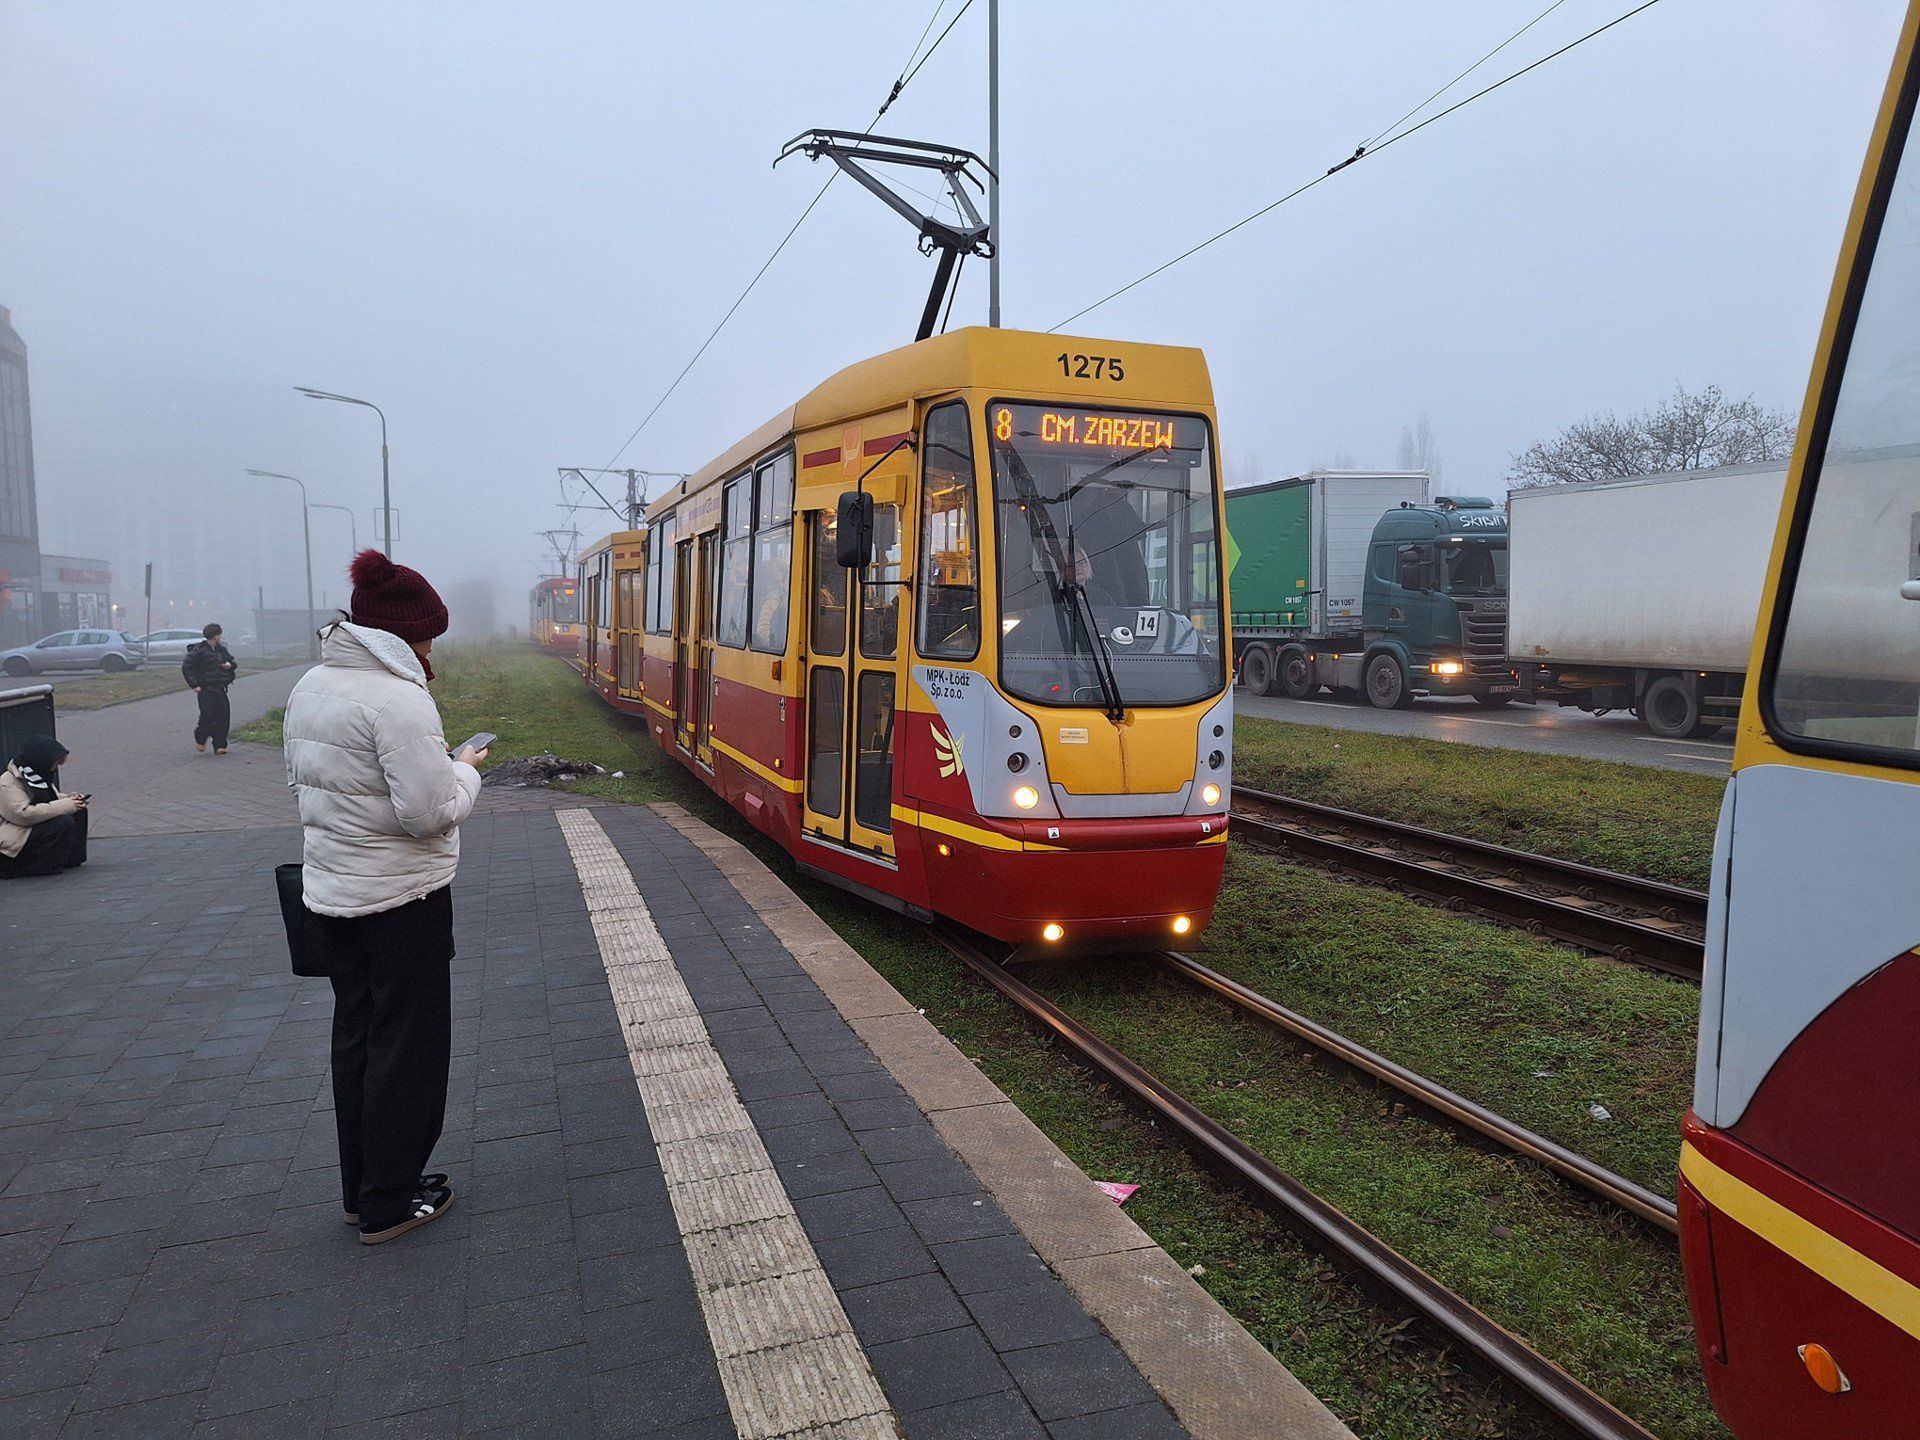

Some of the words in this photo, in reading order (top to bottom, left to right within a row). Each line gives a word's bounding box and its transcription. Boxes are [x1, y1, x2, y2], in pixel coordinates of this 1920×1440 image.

[1057, 353, 1125, 381] 1275
[996, 408, 1013, 441] 8
[1140, 616, 1155, 632] 14
[930, 683, 943, 699] Sp.
